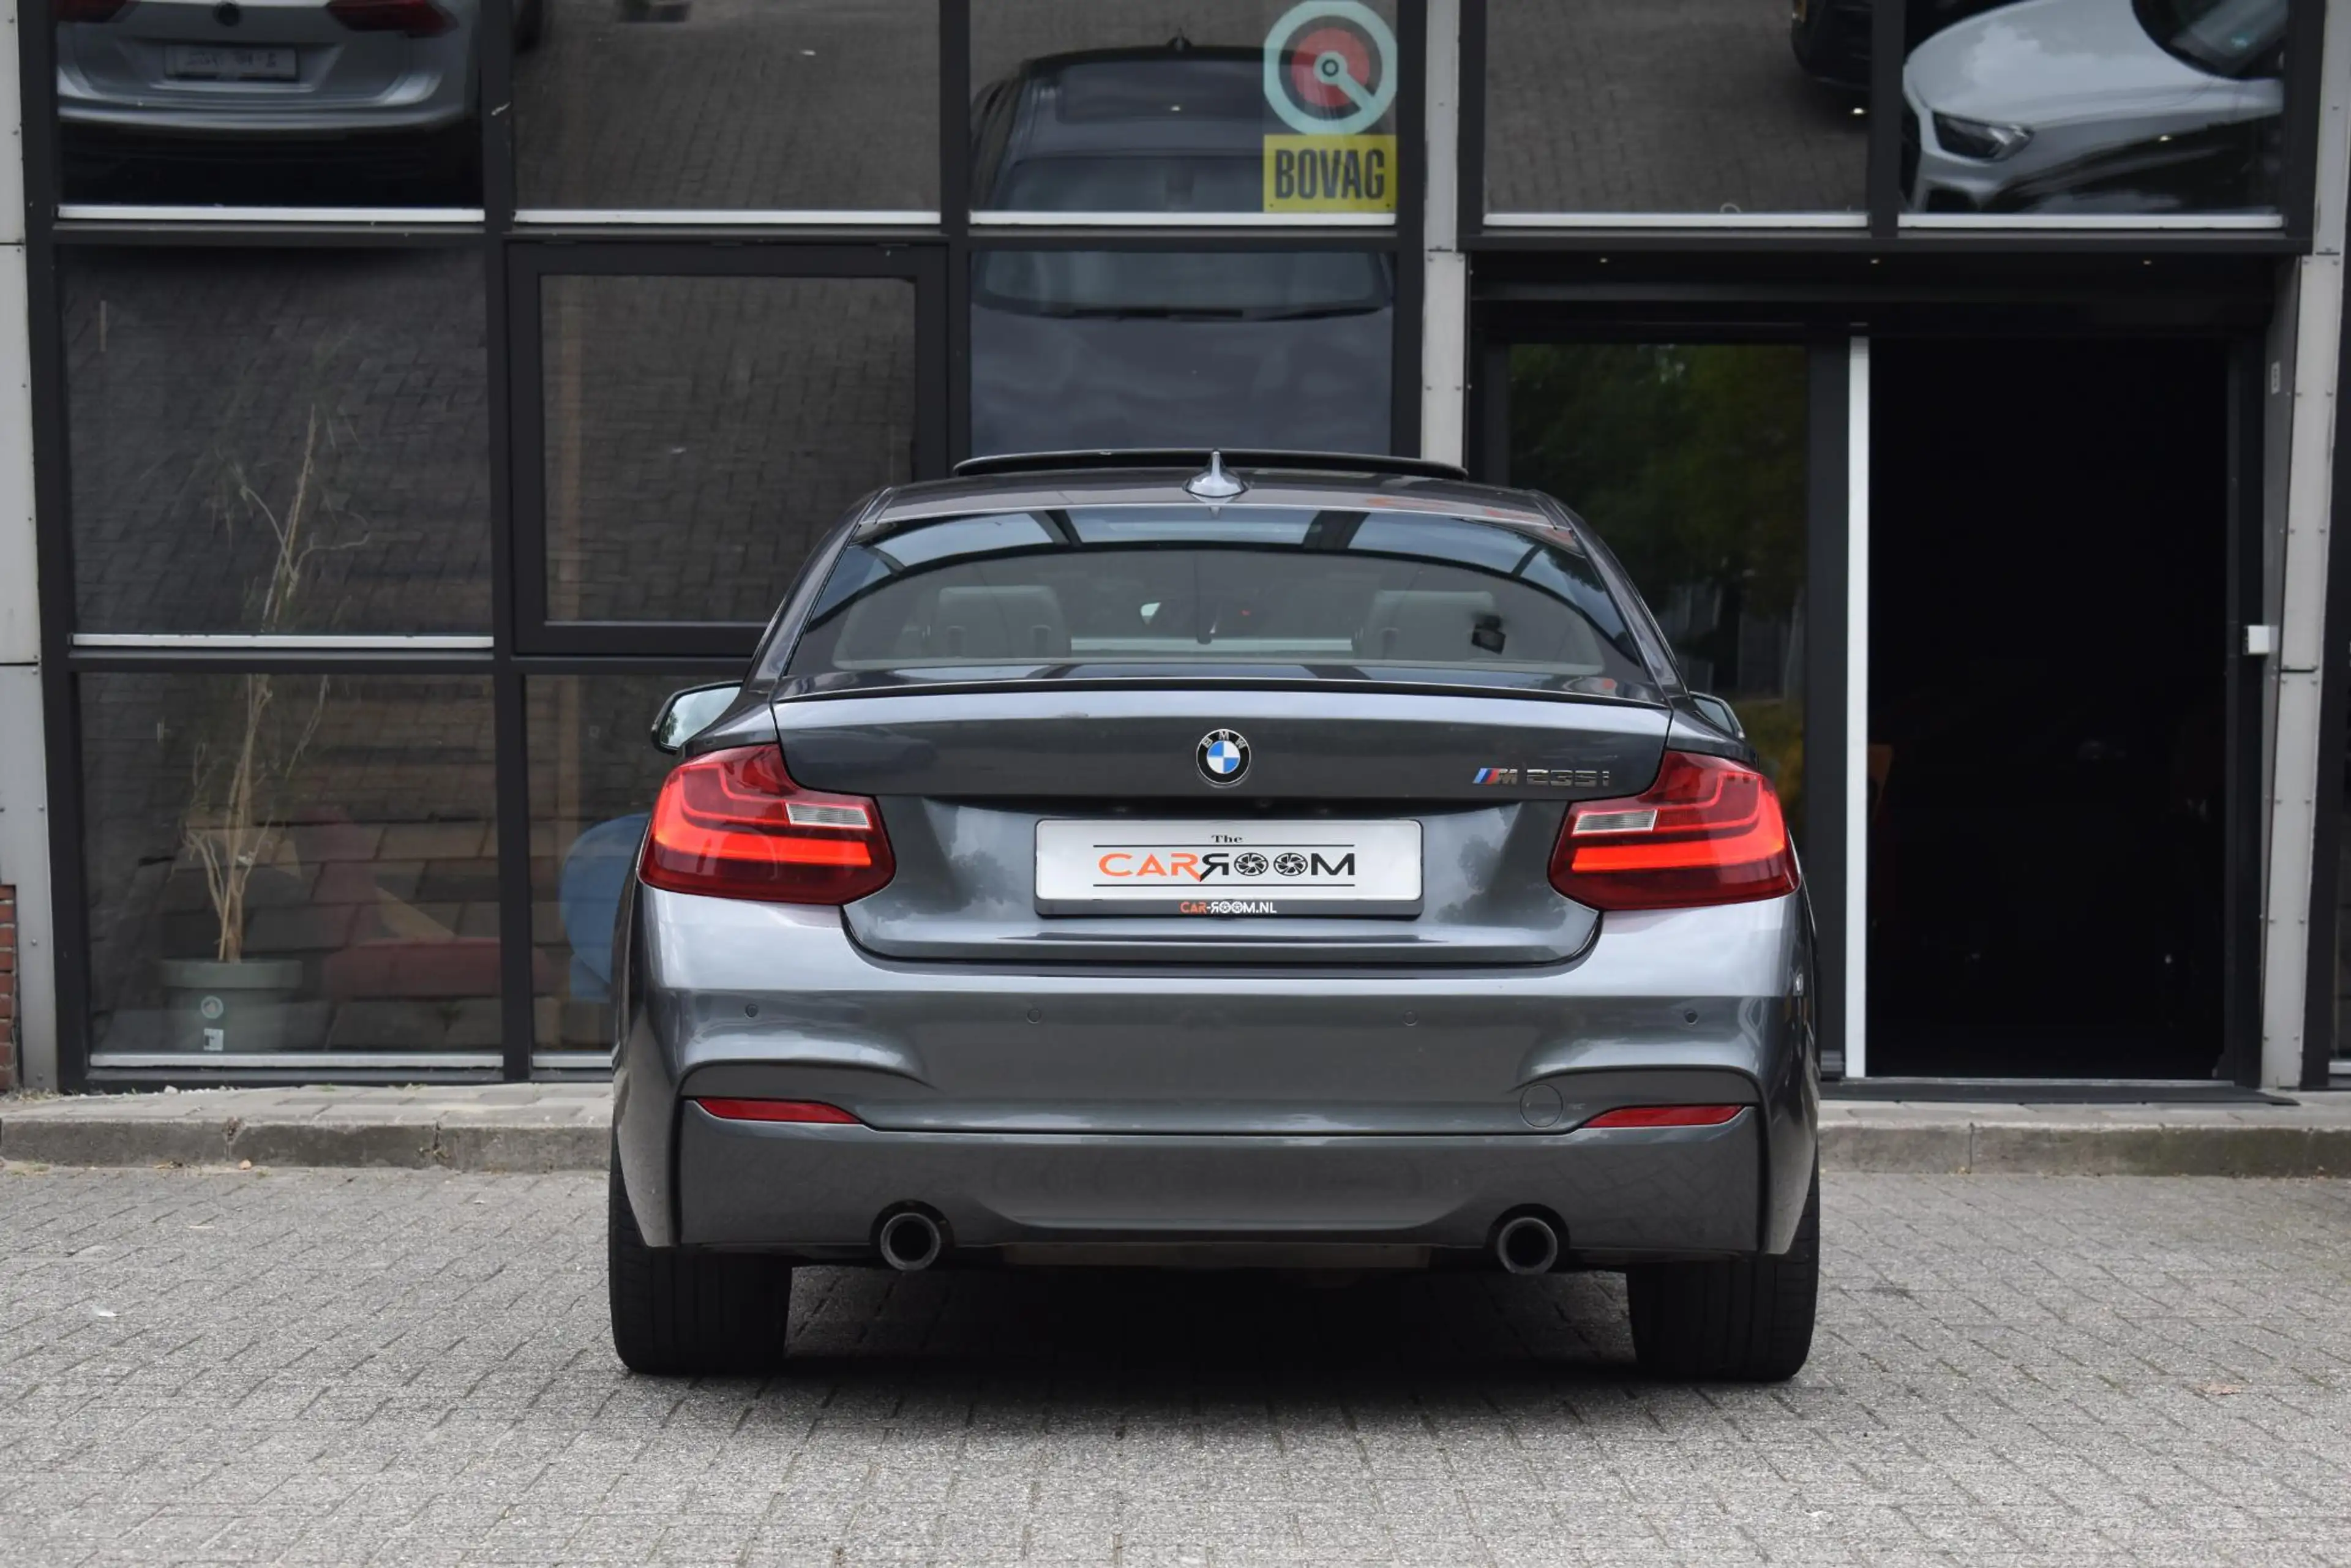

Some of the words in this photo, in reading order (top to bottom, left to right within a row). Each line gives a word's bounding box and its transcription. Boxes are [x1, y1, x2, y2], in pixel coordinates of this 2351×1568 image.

[1275, 148, 1385, 200] BOVAG
[1201, 730, 1247, 749] BMW
[1211, 835, 1243, 844] The
[1180, 901, 1277, 914] CAR-ROOM.NL
